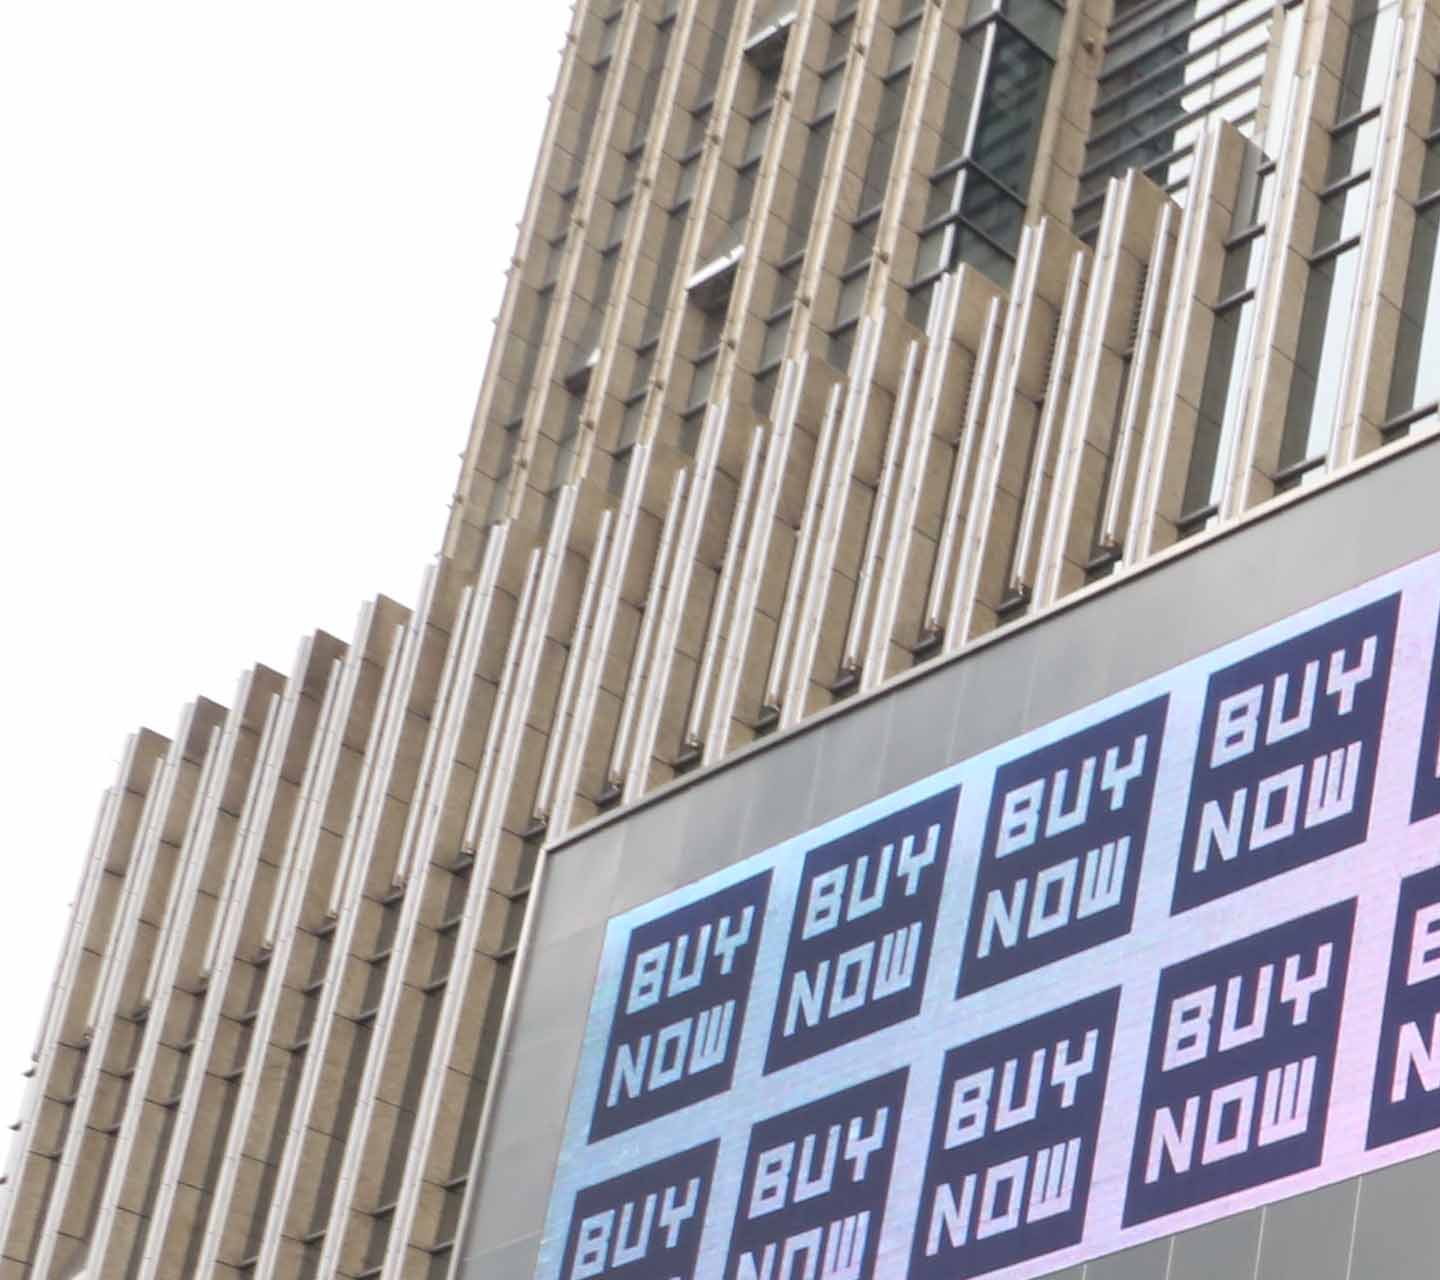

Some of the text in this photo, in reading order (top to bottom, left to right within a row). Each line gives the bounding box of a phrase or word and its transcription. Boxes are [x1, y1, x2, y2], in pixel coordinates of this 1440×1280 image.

[1210, 635, 1377, 768] BUY
[995, 734, 1147, 858] BUY
[1193, 741, 1362, 872] NOW
[802, 824, 940, 940] BUY
[977, 836, 1130, 958] NOW
[627, 906, 754, 1014] BUY
[784, 922, 922, 1036] NOW
[1162, 943, 1332, 1071] BUY
[607, 1000, 735, 1106] NOW
[944, 1029, 1098, 1149] BUY
[748, 1107, 888, 1218] BUY
[1145, 1056, 1317, 1183] NOW
[926, 1138, 1081, 1256] NOW
